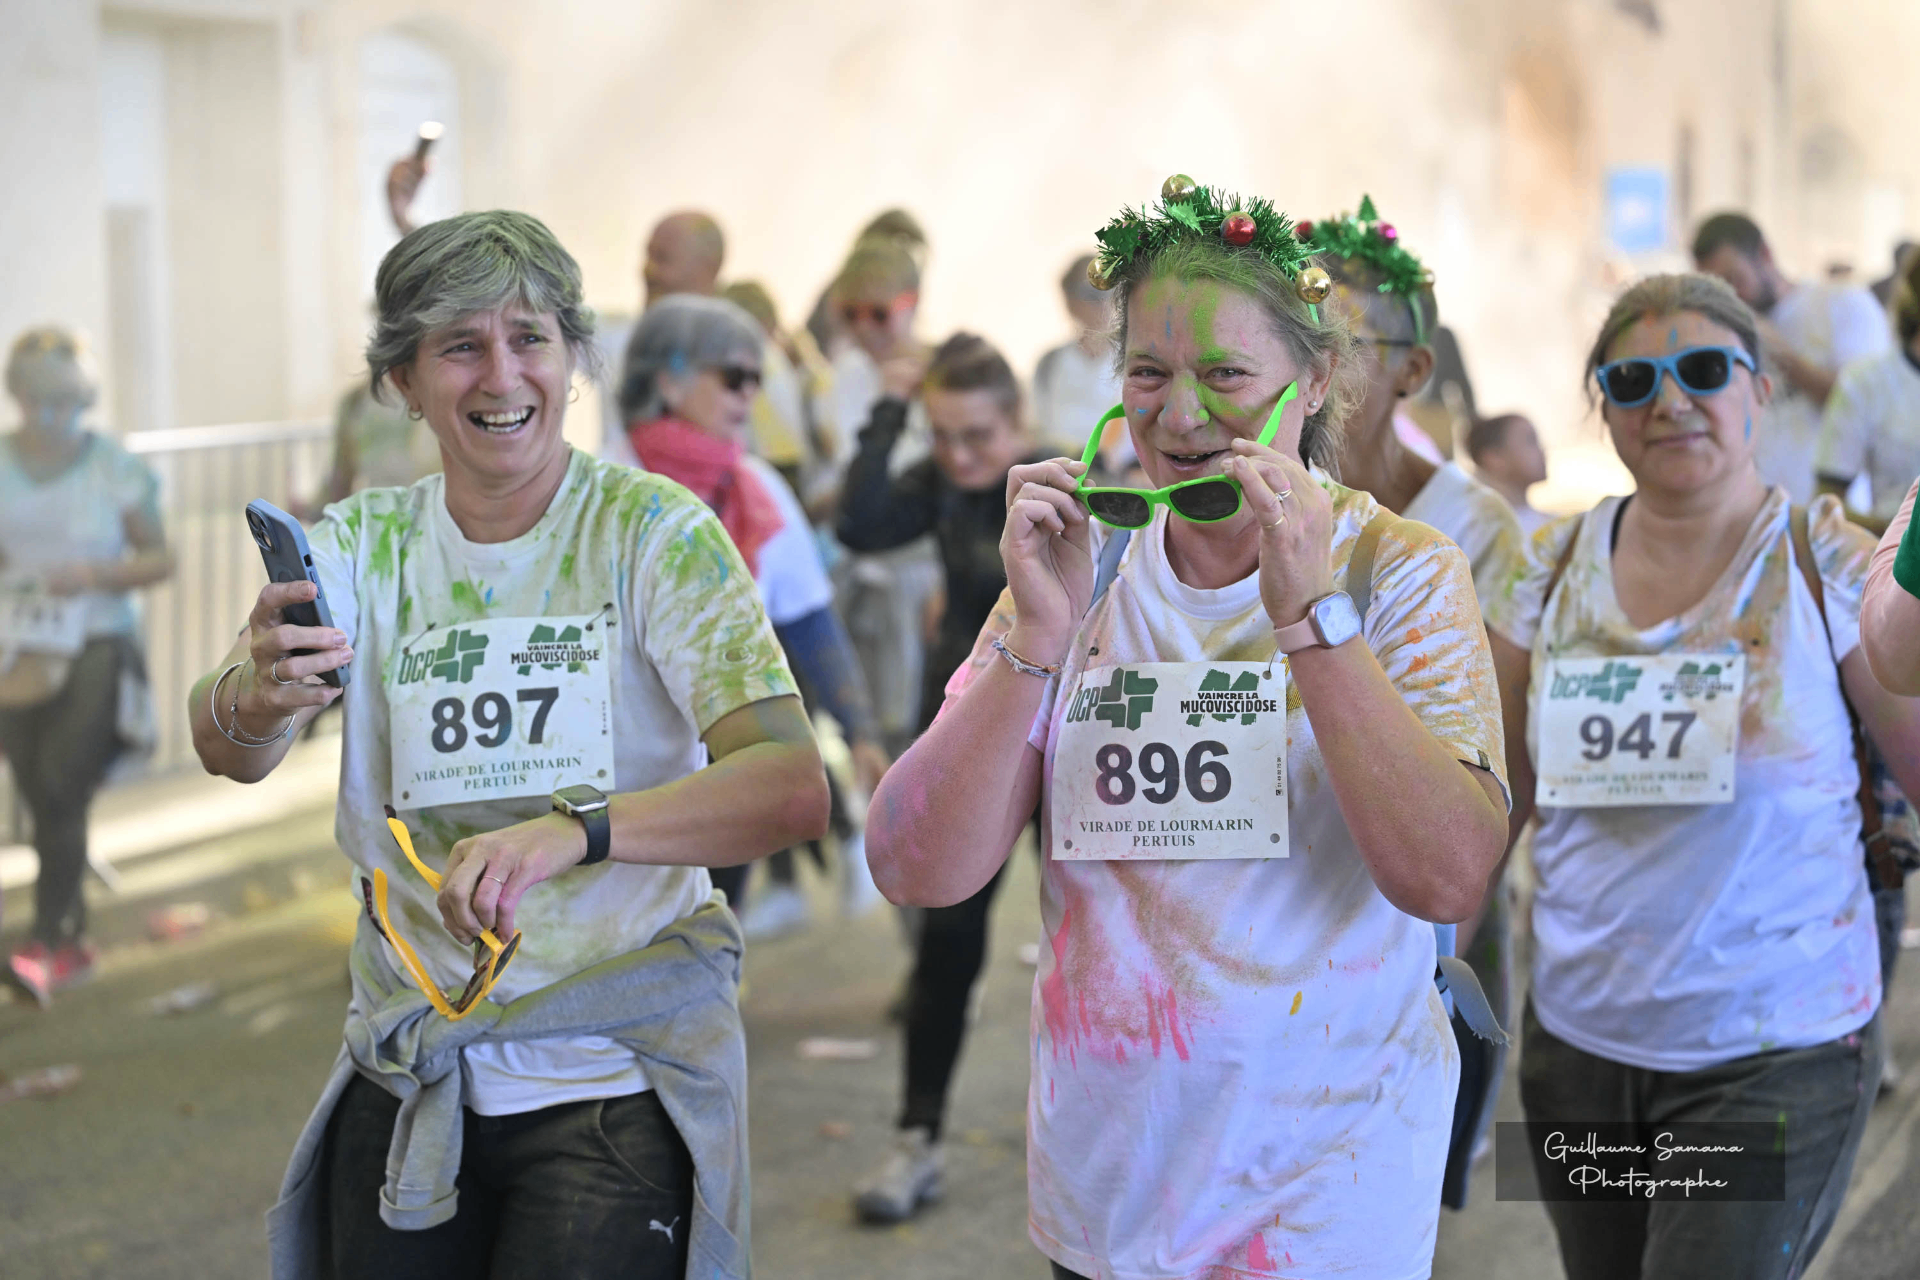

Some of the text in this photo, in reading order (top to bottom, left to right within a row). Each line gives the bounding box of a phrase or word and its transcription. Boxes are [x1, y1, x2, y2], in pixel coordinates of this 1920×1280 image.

[527, 643, 569, 651] VAINCRE
[511, 649, 600, 665] MUCOVISCIDOSE
[1197, 692, 1259, 700] VAINCRE LA
[1180, 699, 1277, 714] MUCOVISCIDOSE
[431, 686, 559, 753] 897
[1579, 712, 1697, 762] 947
[414, 756, 582, 783] VIRADE DE LOURMARIN
[1095, 740, 1232, 806] 896
[464, 774, 527, 790] PERTUIS
[1079, 818, 1254, 832] VIRADE DE LOURMARIN
[1133, 835, 1196, 847] PERTUIS
